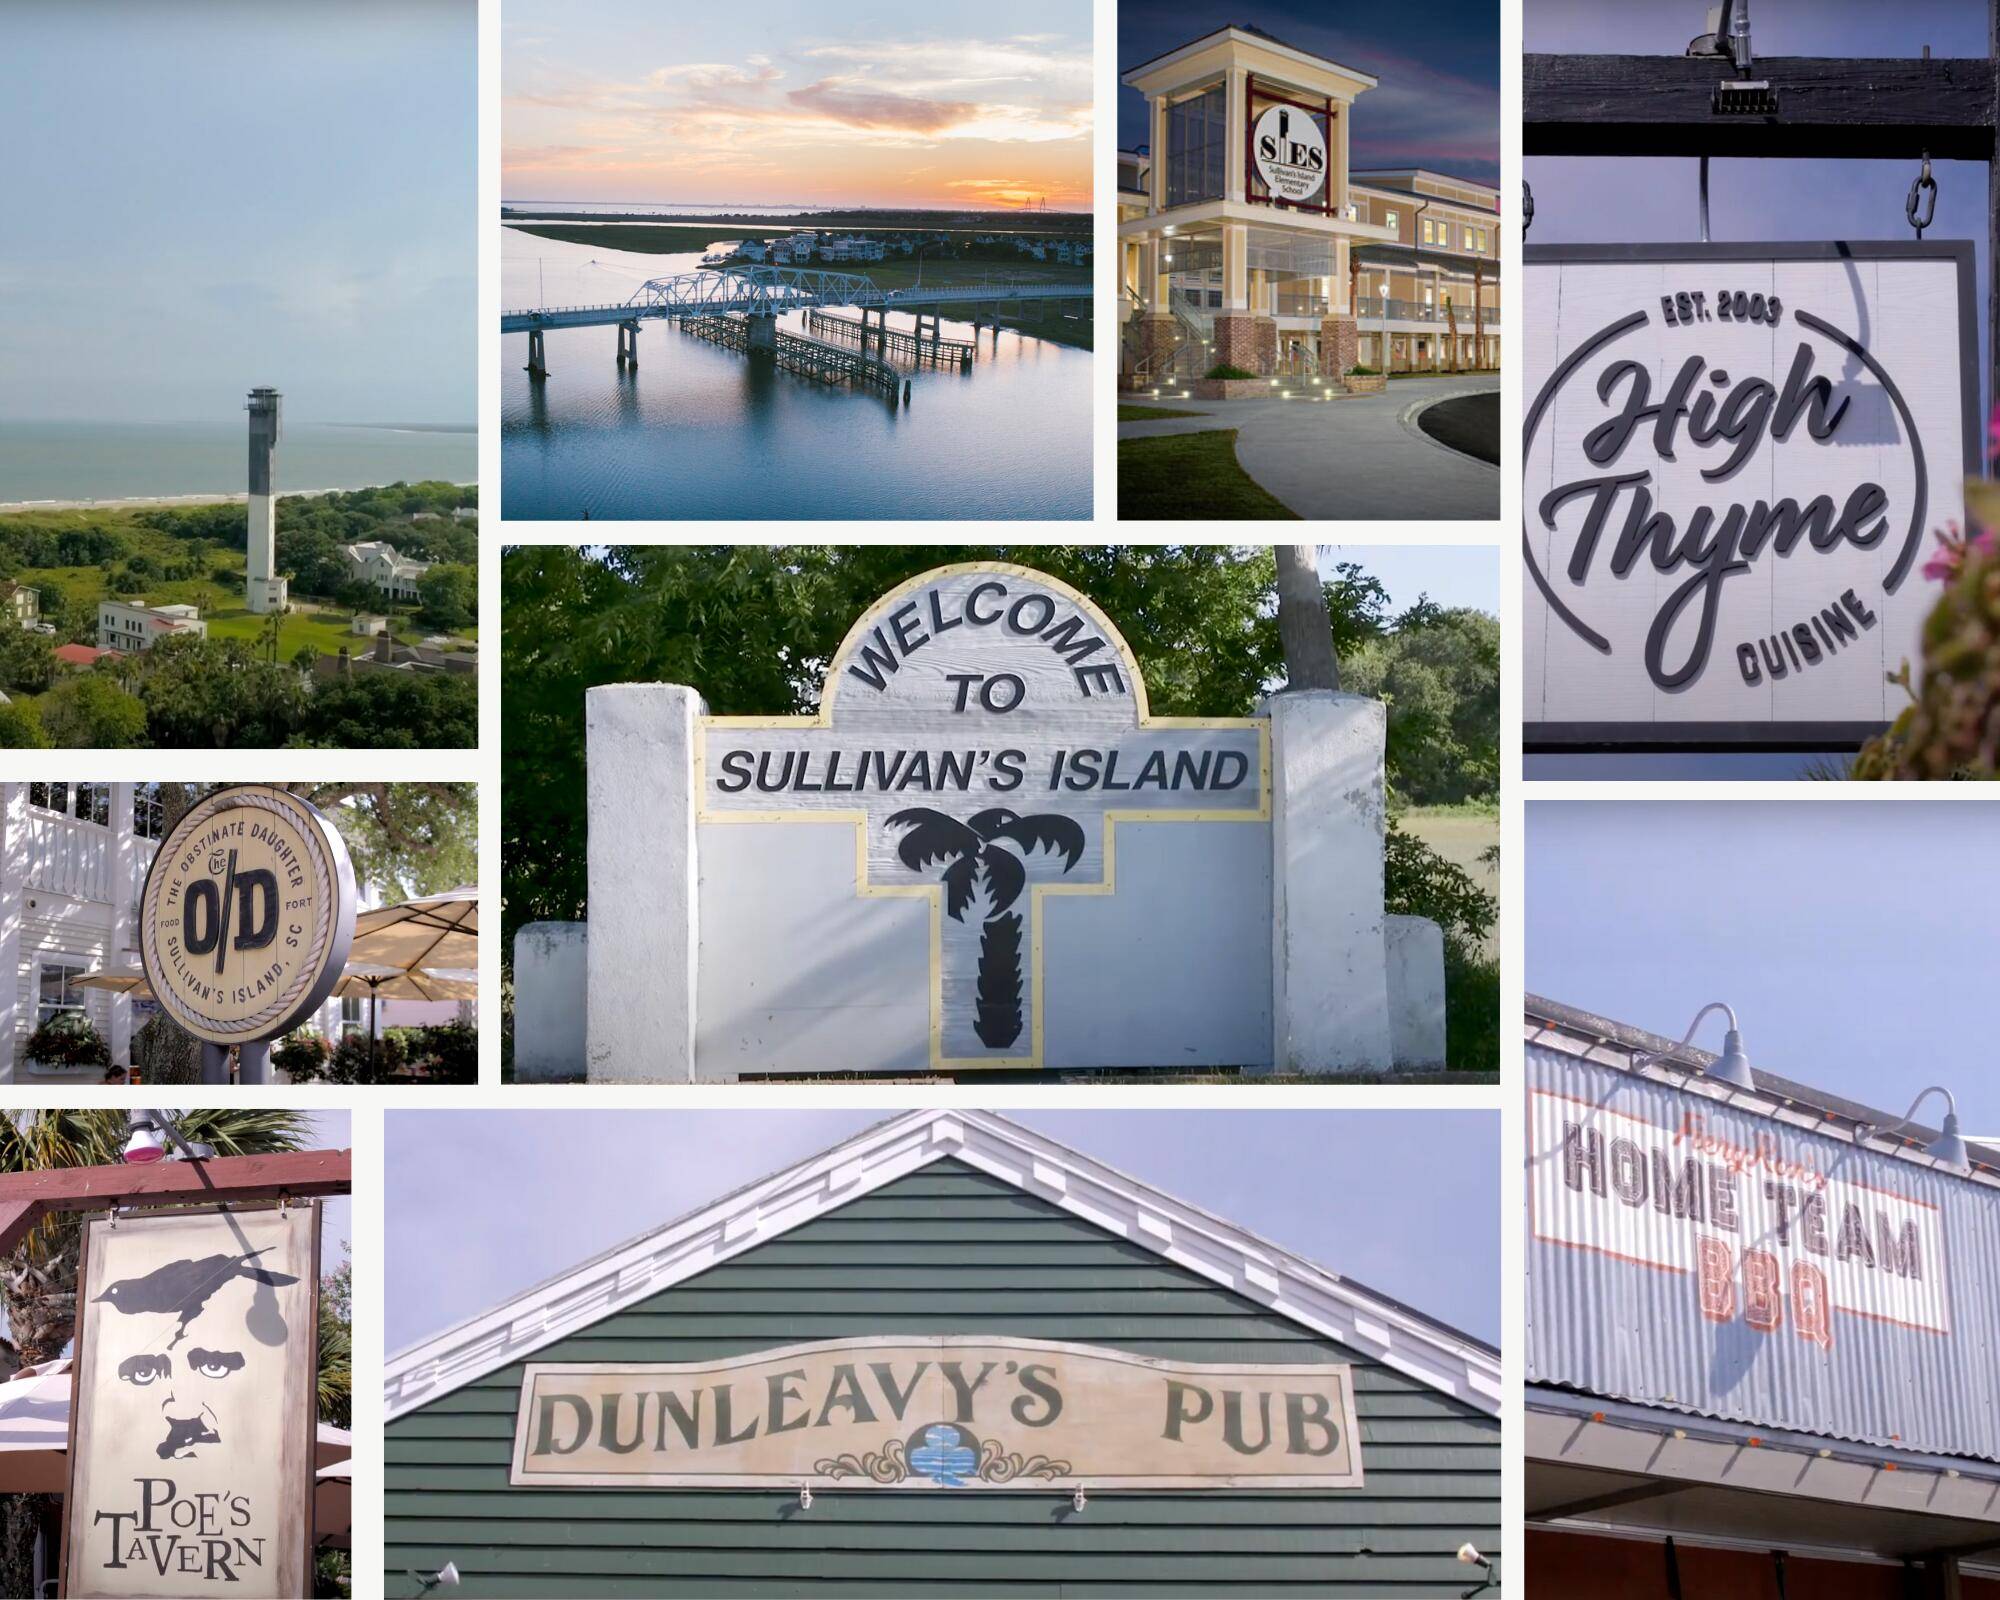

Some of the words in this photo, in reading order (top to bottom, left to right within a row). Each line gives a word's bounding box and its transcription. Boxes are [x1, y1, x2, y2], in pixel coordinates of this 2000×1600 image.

[1274, 174, 1310, 191] Elementary
[1281, 184, 1303, 195] School
[1297, 171, 1316, 182] Island
[1660, 291, 1711, 327] EST.
[1717, 290, 1783, 327] 2003
[1583, 342, 1851, 482] High
[1538, 469, 1890, 694] Thyme
[848, 581, 1127, 698] WELCOME
[1736, 588, 1877, 686] CUISINE
[945, 673, 1026, 714] TO
[716, 749, 1026, 793] SULLIVAN'S
[1049, 749, 1249, 792] ISLAND
[167, 878, 182, 906] THE
[180, 821, 245, 873] OBSTINATE
[250, 823, 304, 889] DAUGHTER
[208, 848, 227, 875] The
[160, 918, 180, 928] FOOD
[285, 897, 313, 911] FORT
[167, 936, 224, 1005] SULLIVAN'S
[232, 960, 290, 1004] ISLAND,
[286, 923, 303, 948] SC
[1562, 1119, 1739, 1234] HOME
[1764, 1178, 1922, 1282] TEAM
[1696, 1232, 1833, 1350] BBQ
[531, 1360, 1064, 1457] DUNLEAVY'S
[1160, 1377, 1341, 1457] PUB
